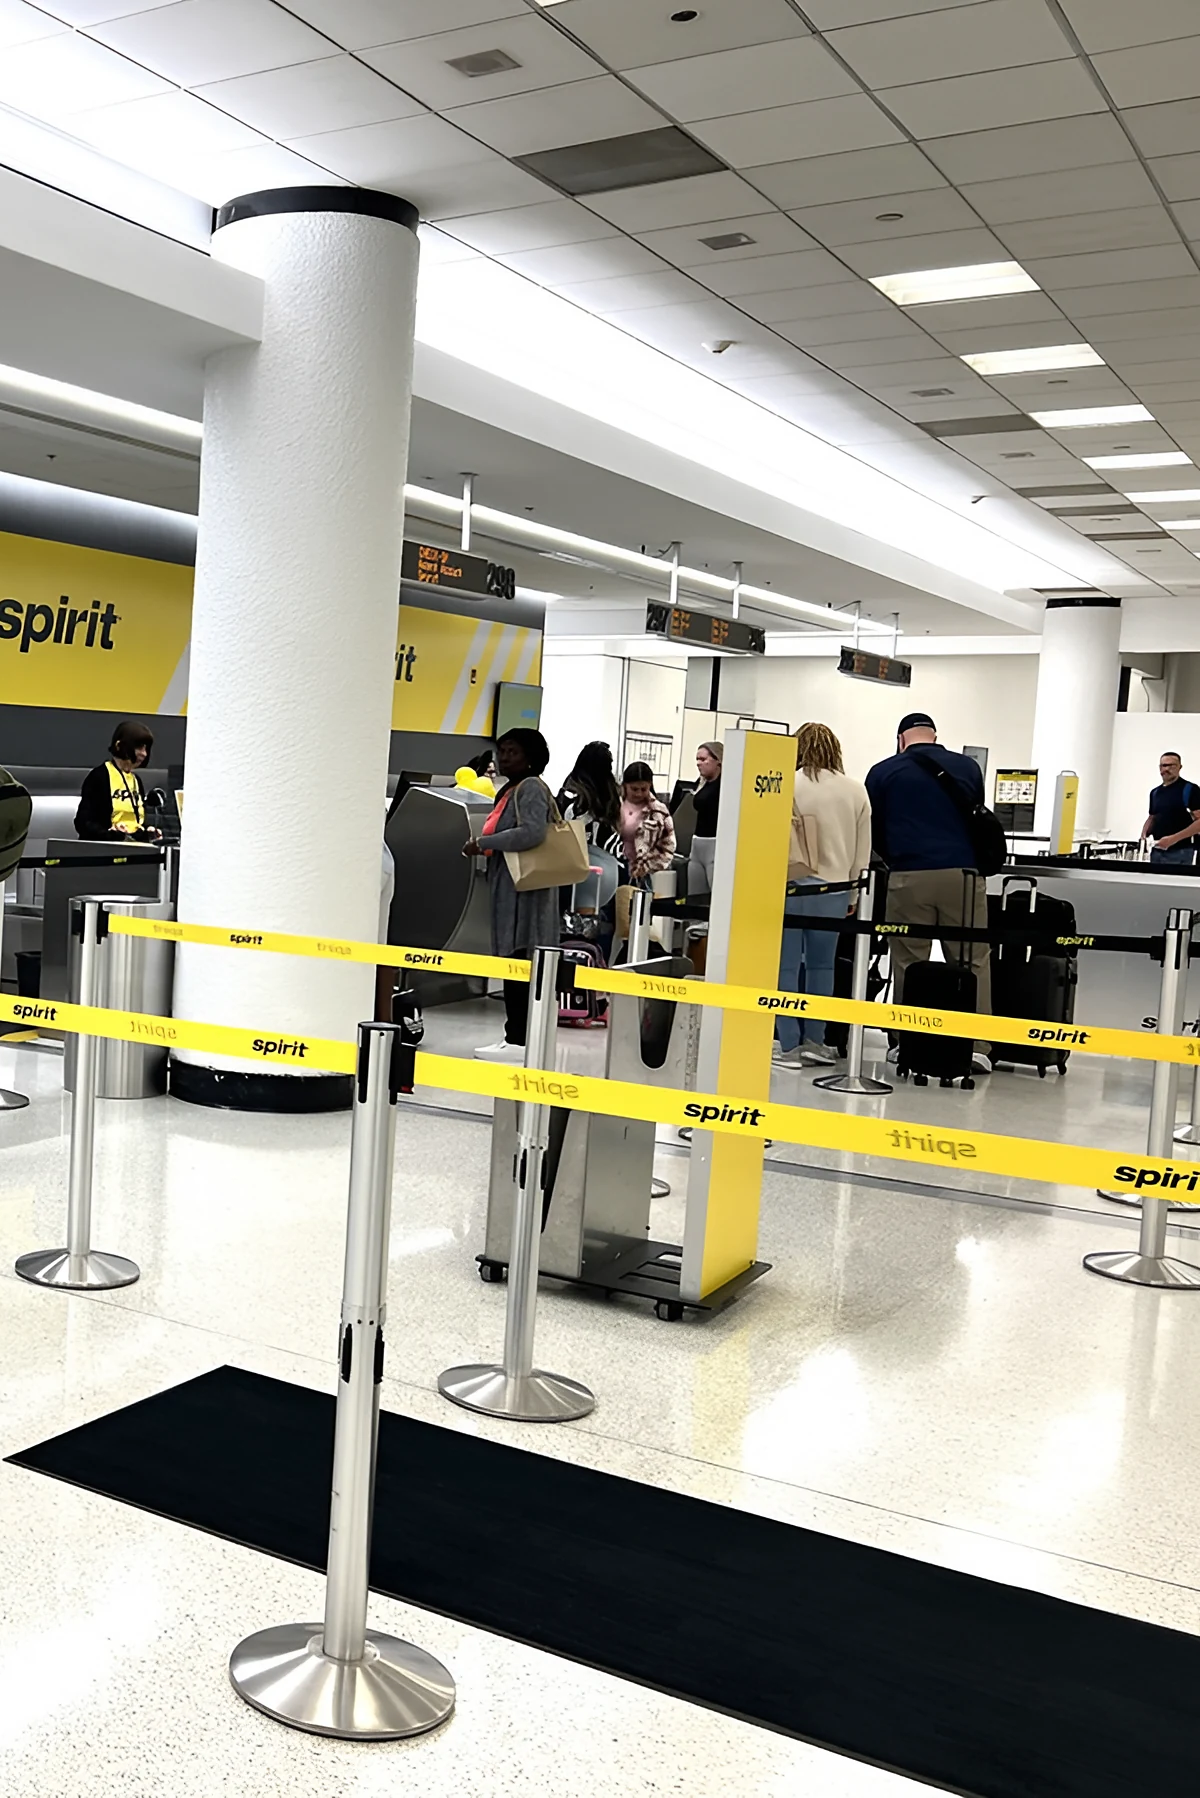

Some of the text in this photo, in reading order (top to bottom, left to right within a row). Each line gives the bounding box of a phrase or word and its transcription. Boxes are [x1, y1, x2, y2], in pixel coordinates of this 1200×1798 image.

[754, 770, 784, 798] spirit
[404, 952, 445, 966] spirit
[13, 1002, 58, 1022] spirit
[757, 994, 811, 1013] spirit
[1027, 1026, 1092, 1046] spirit
[251, 1037, 310, 1059] spirit
[683, 1102, 766, 1127] spirit
[1113, 1165, 1200, 1191] spiri
